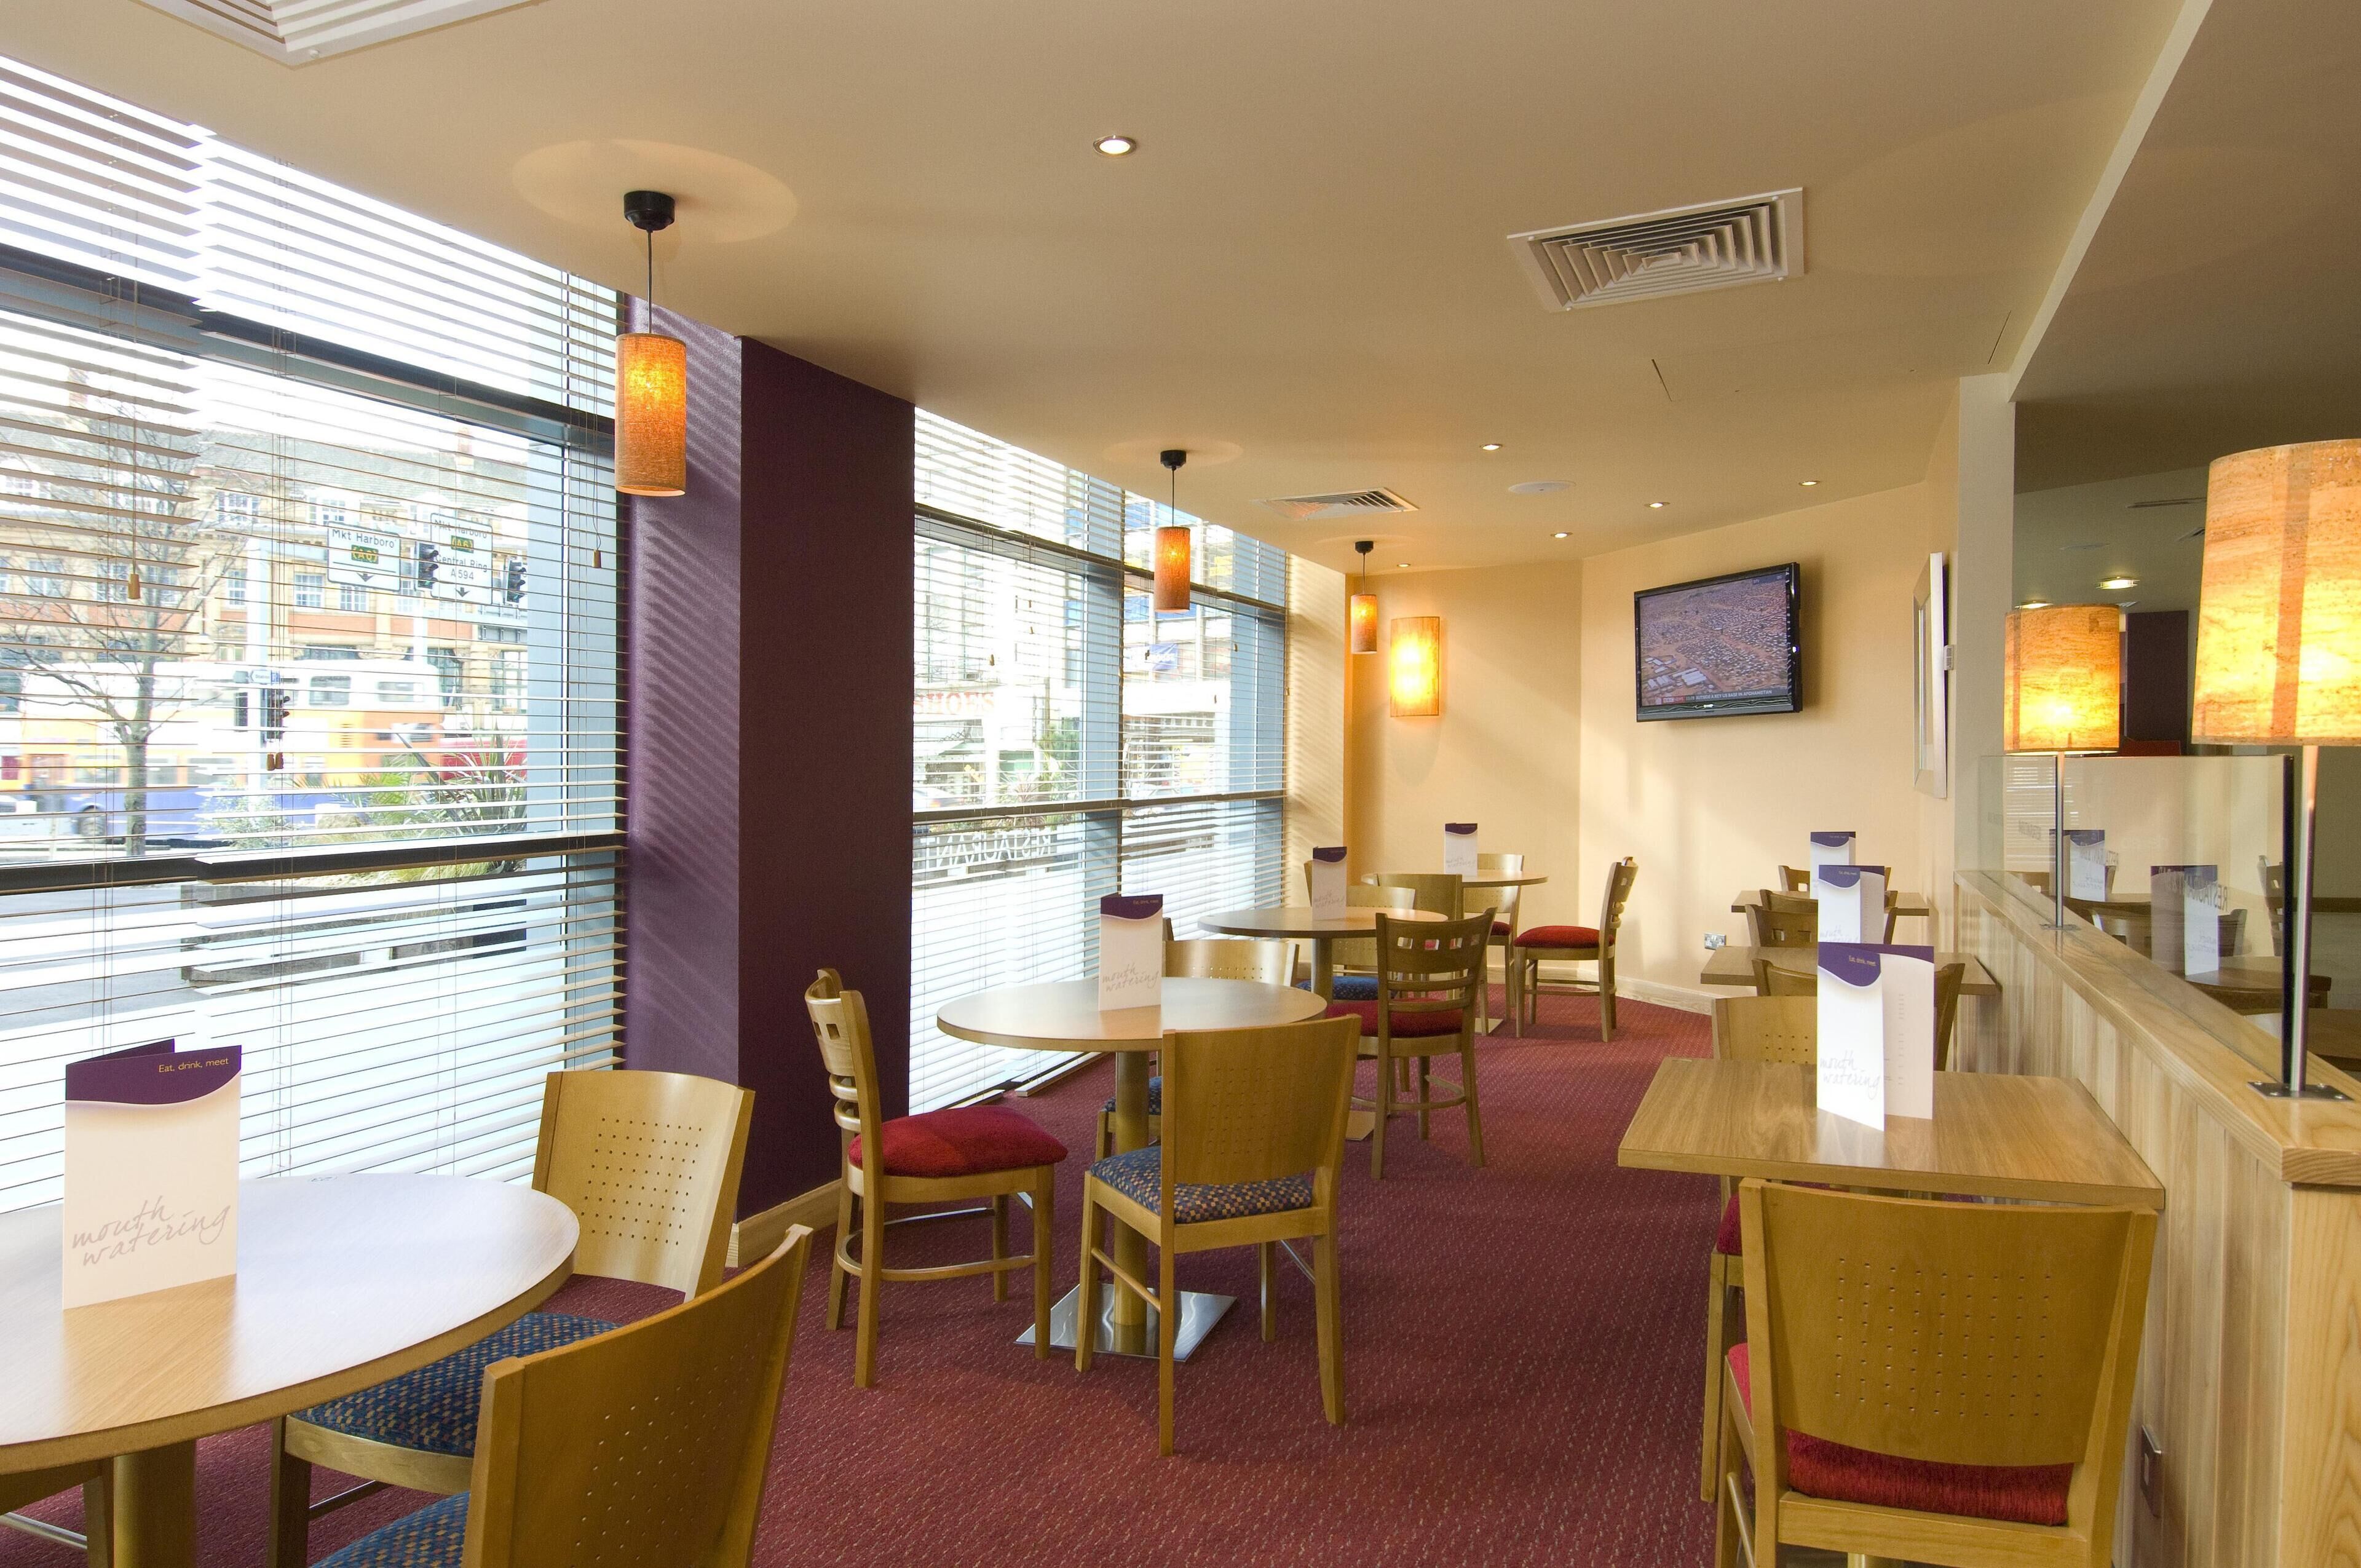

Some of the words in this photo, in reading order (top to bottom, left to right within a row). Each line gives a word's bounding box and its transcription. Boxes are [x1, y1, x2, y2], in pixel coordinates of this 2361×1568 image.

[332, 528, 352, 540] Mkt
[435, 555, 466, 566] Central
[470, 560, 488, 573] Ring
[205, 1057, 229, 1067] meet
[71, 1195, 173, 1249] mouth
[82, 1205, 231, 1267] watering
